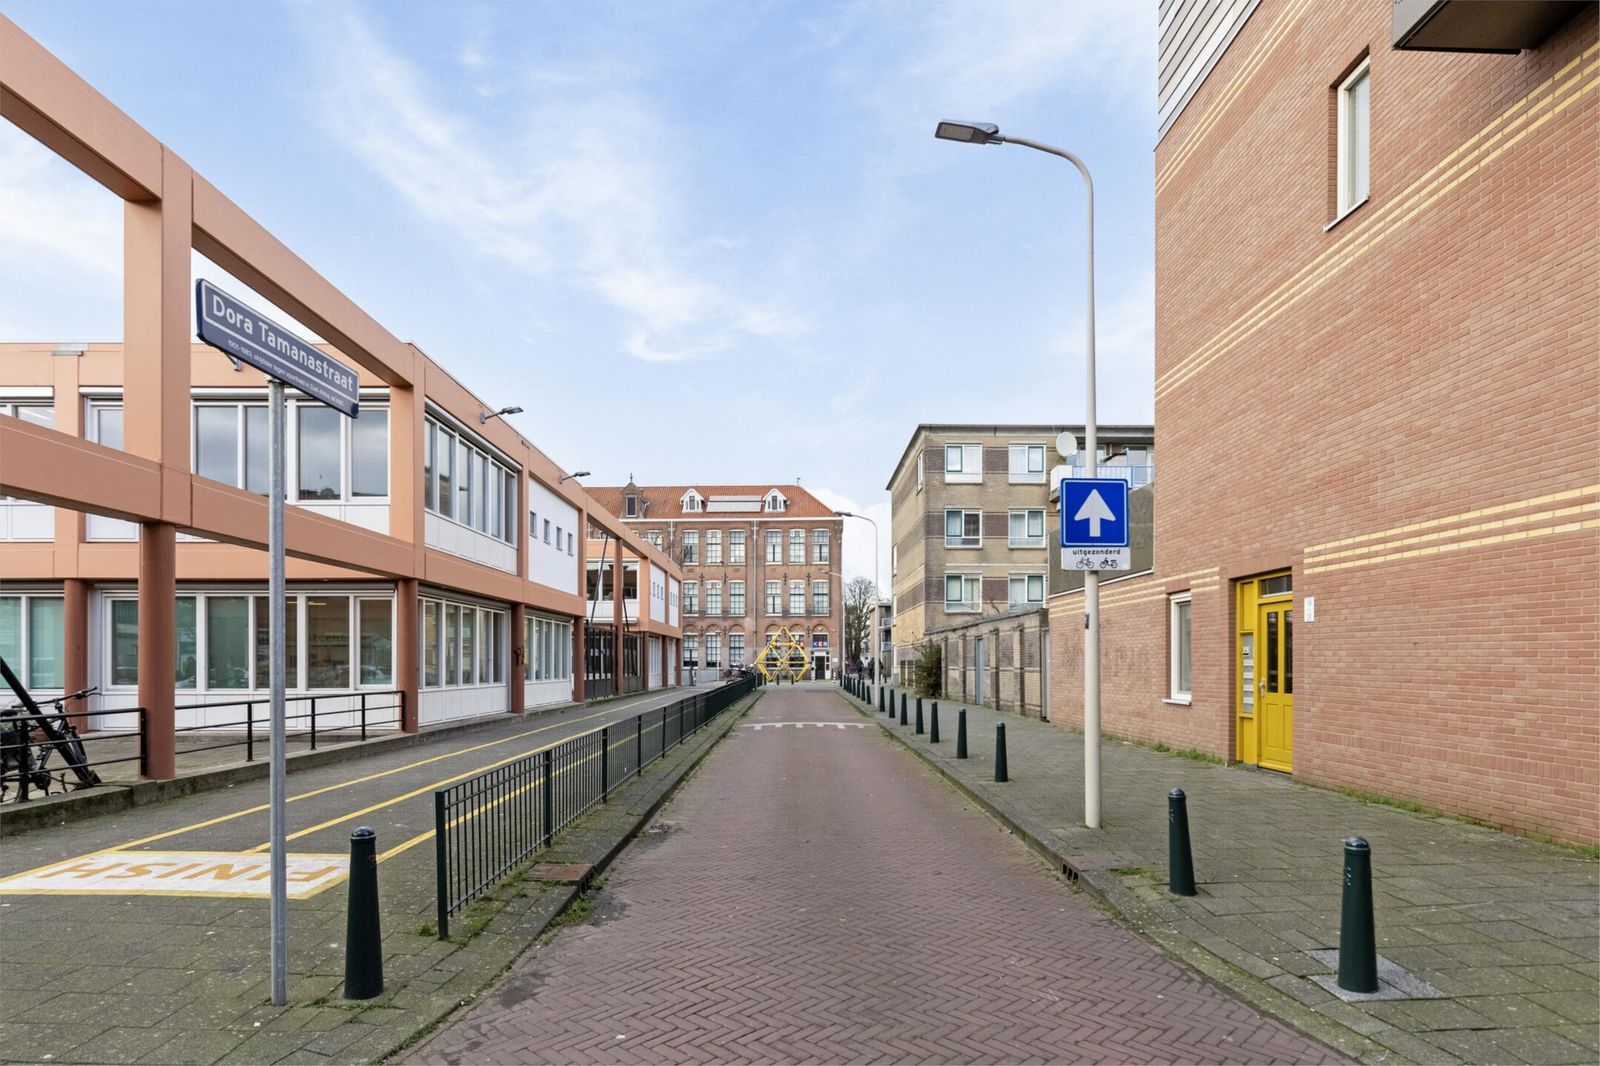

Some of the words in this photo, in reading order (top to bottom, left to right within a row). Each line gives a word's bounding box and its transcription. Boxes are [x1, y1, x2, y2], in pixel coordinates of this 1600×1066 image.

[212, 293, 253, 335] Dora
[258, 321, 354, 393] Tamanastraat
[36, 862, 340, 882] FINISH
